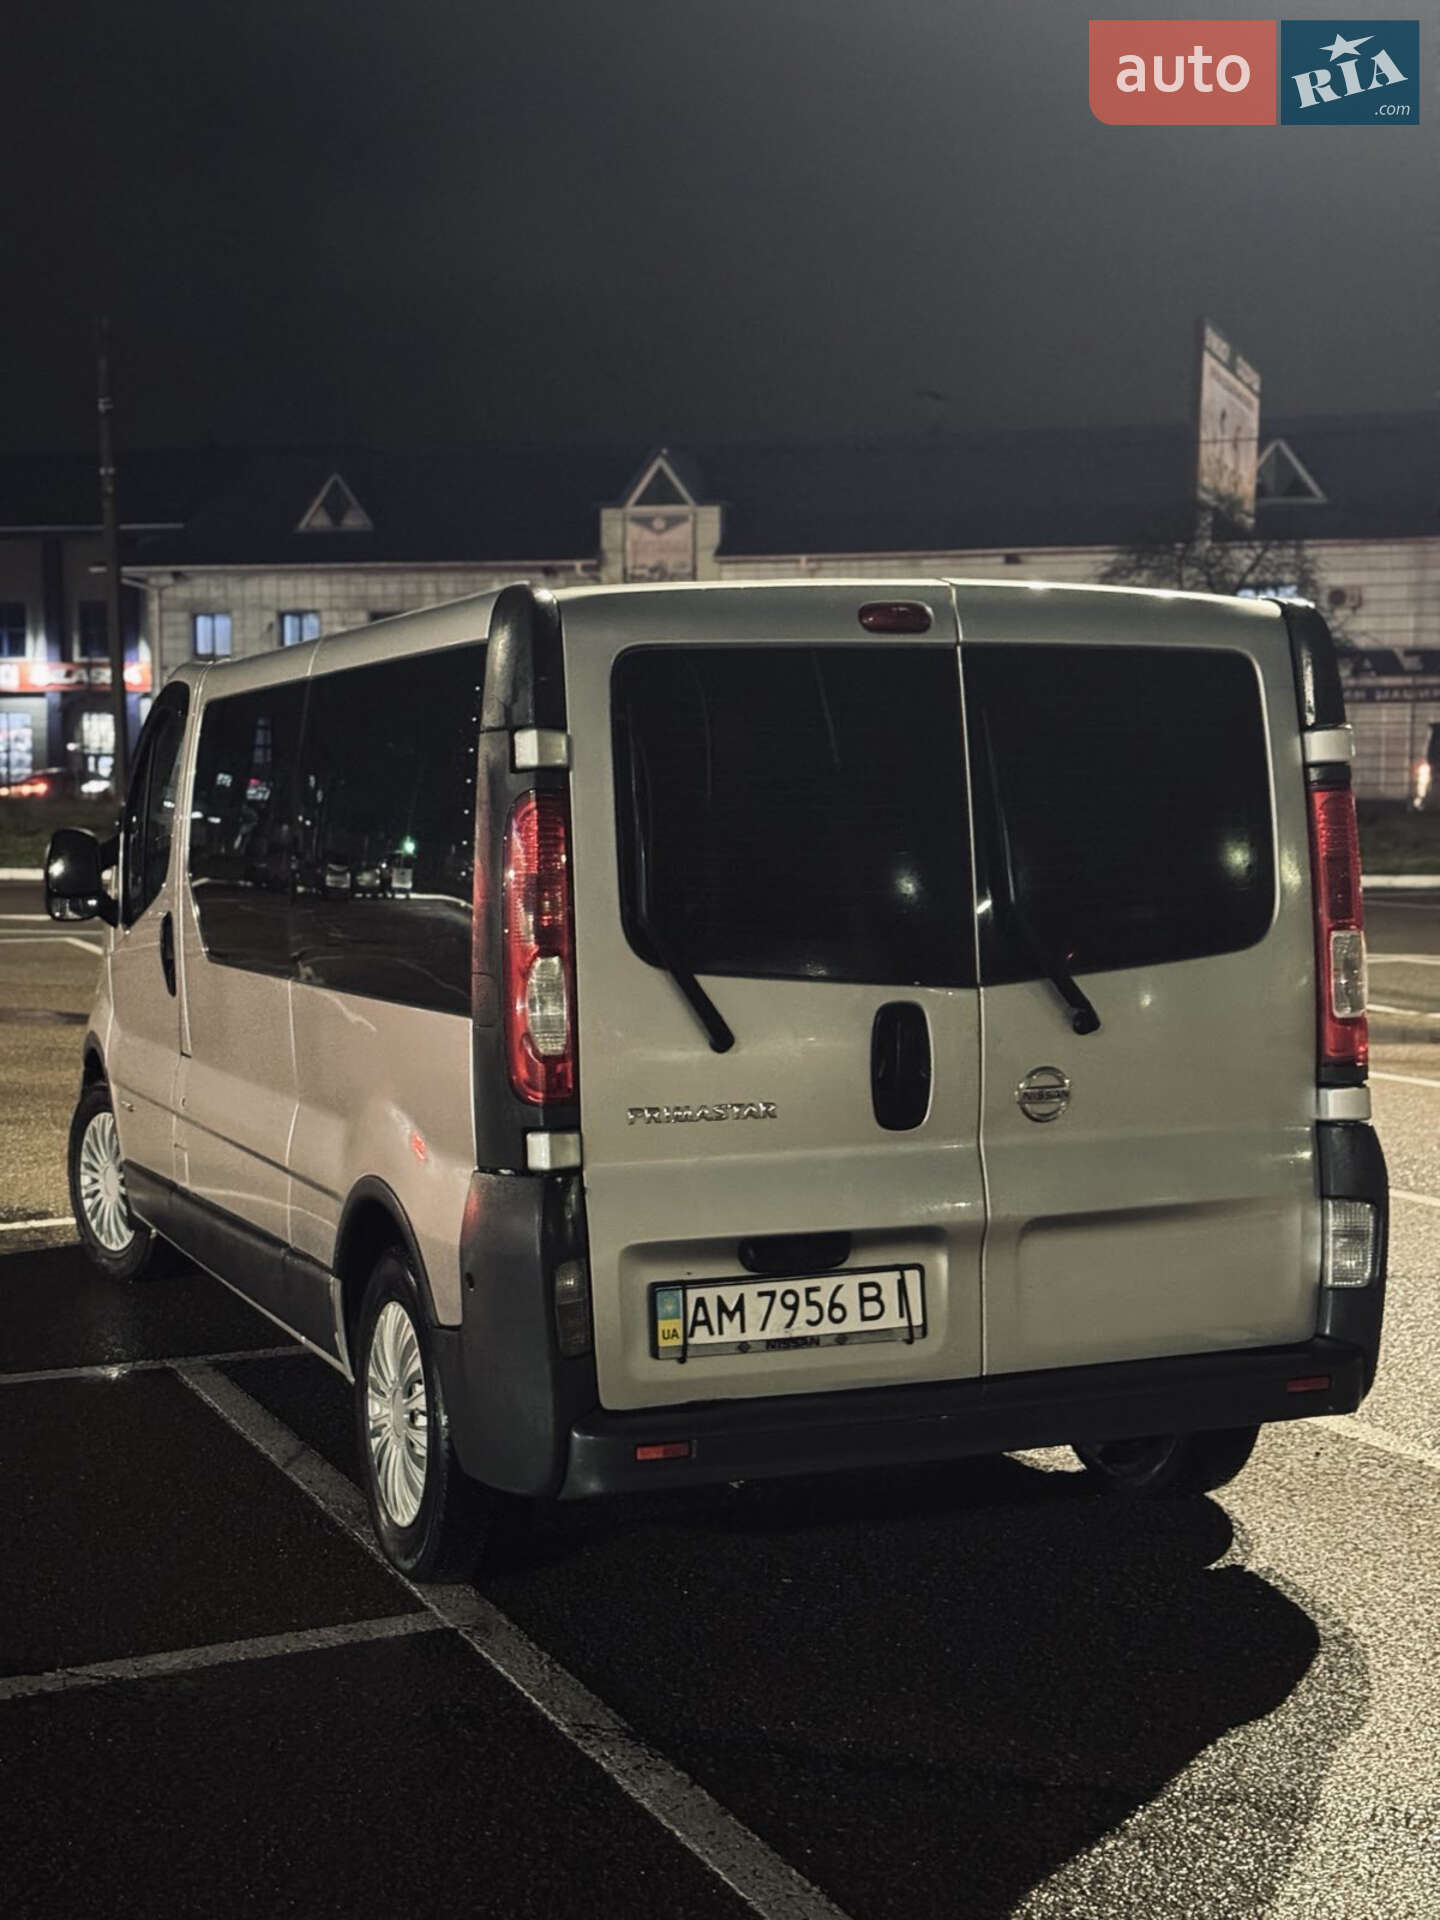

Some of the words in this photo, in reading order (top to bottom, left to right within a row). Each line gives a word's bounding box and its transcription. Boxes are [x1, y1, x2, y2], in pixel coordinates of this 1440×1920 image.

[627, 1102, 778, 1126] PRIMASTAR
[687, 1292, 746, 1339] AM
[756, 1283, 848, 1332] 7956
[857, 1277, 905, 1323] BI
[661, 1327, 681, 1341] UA
